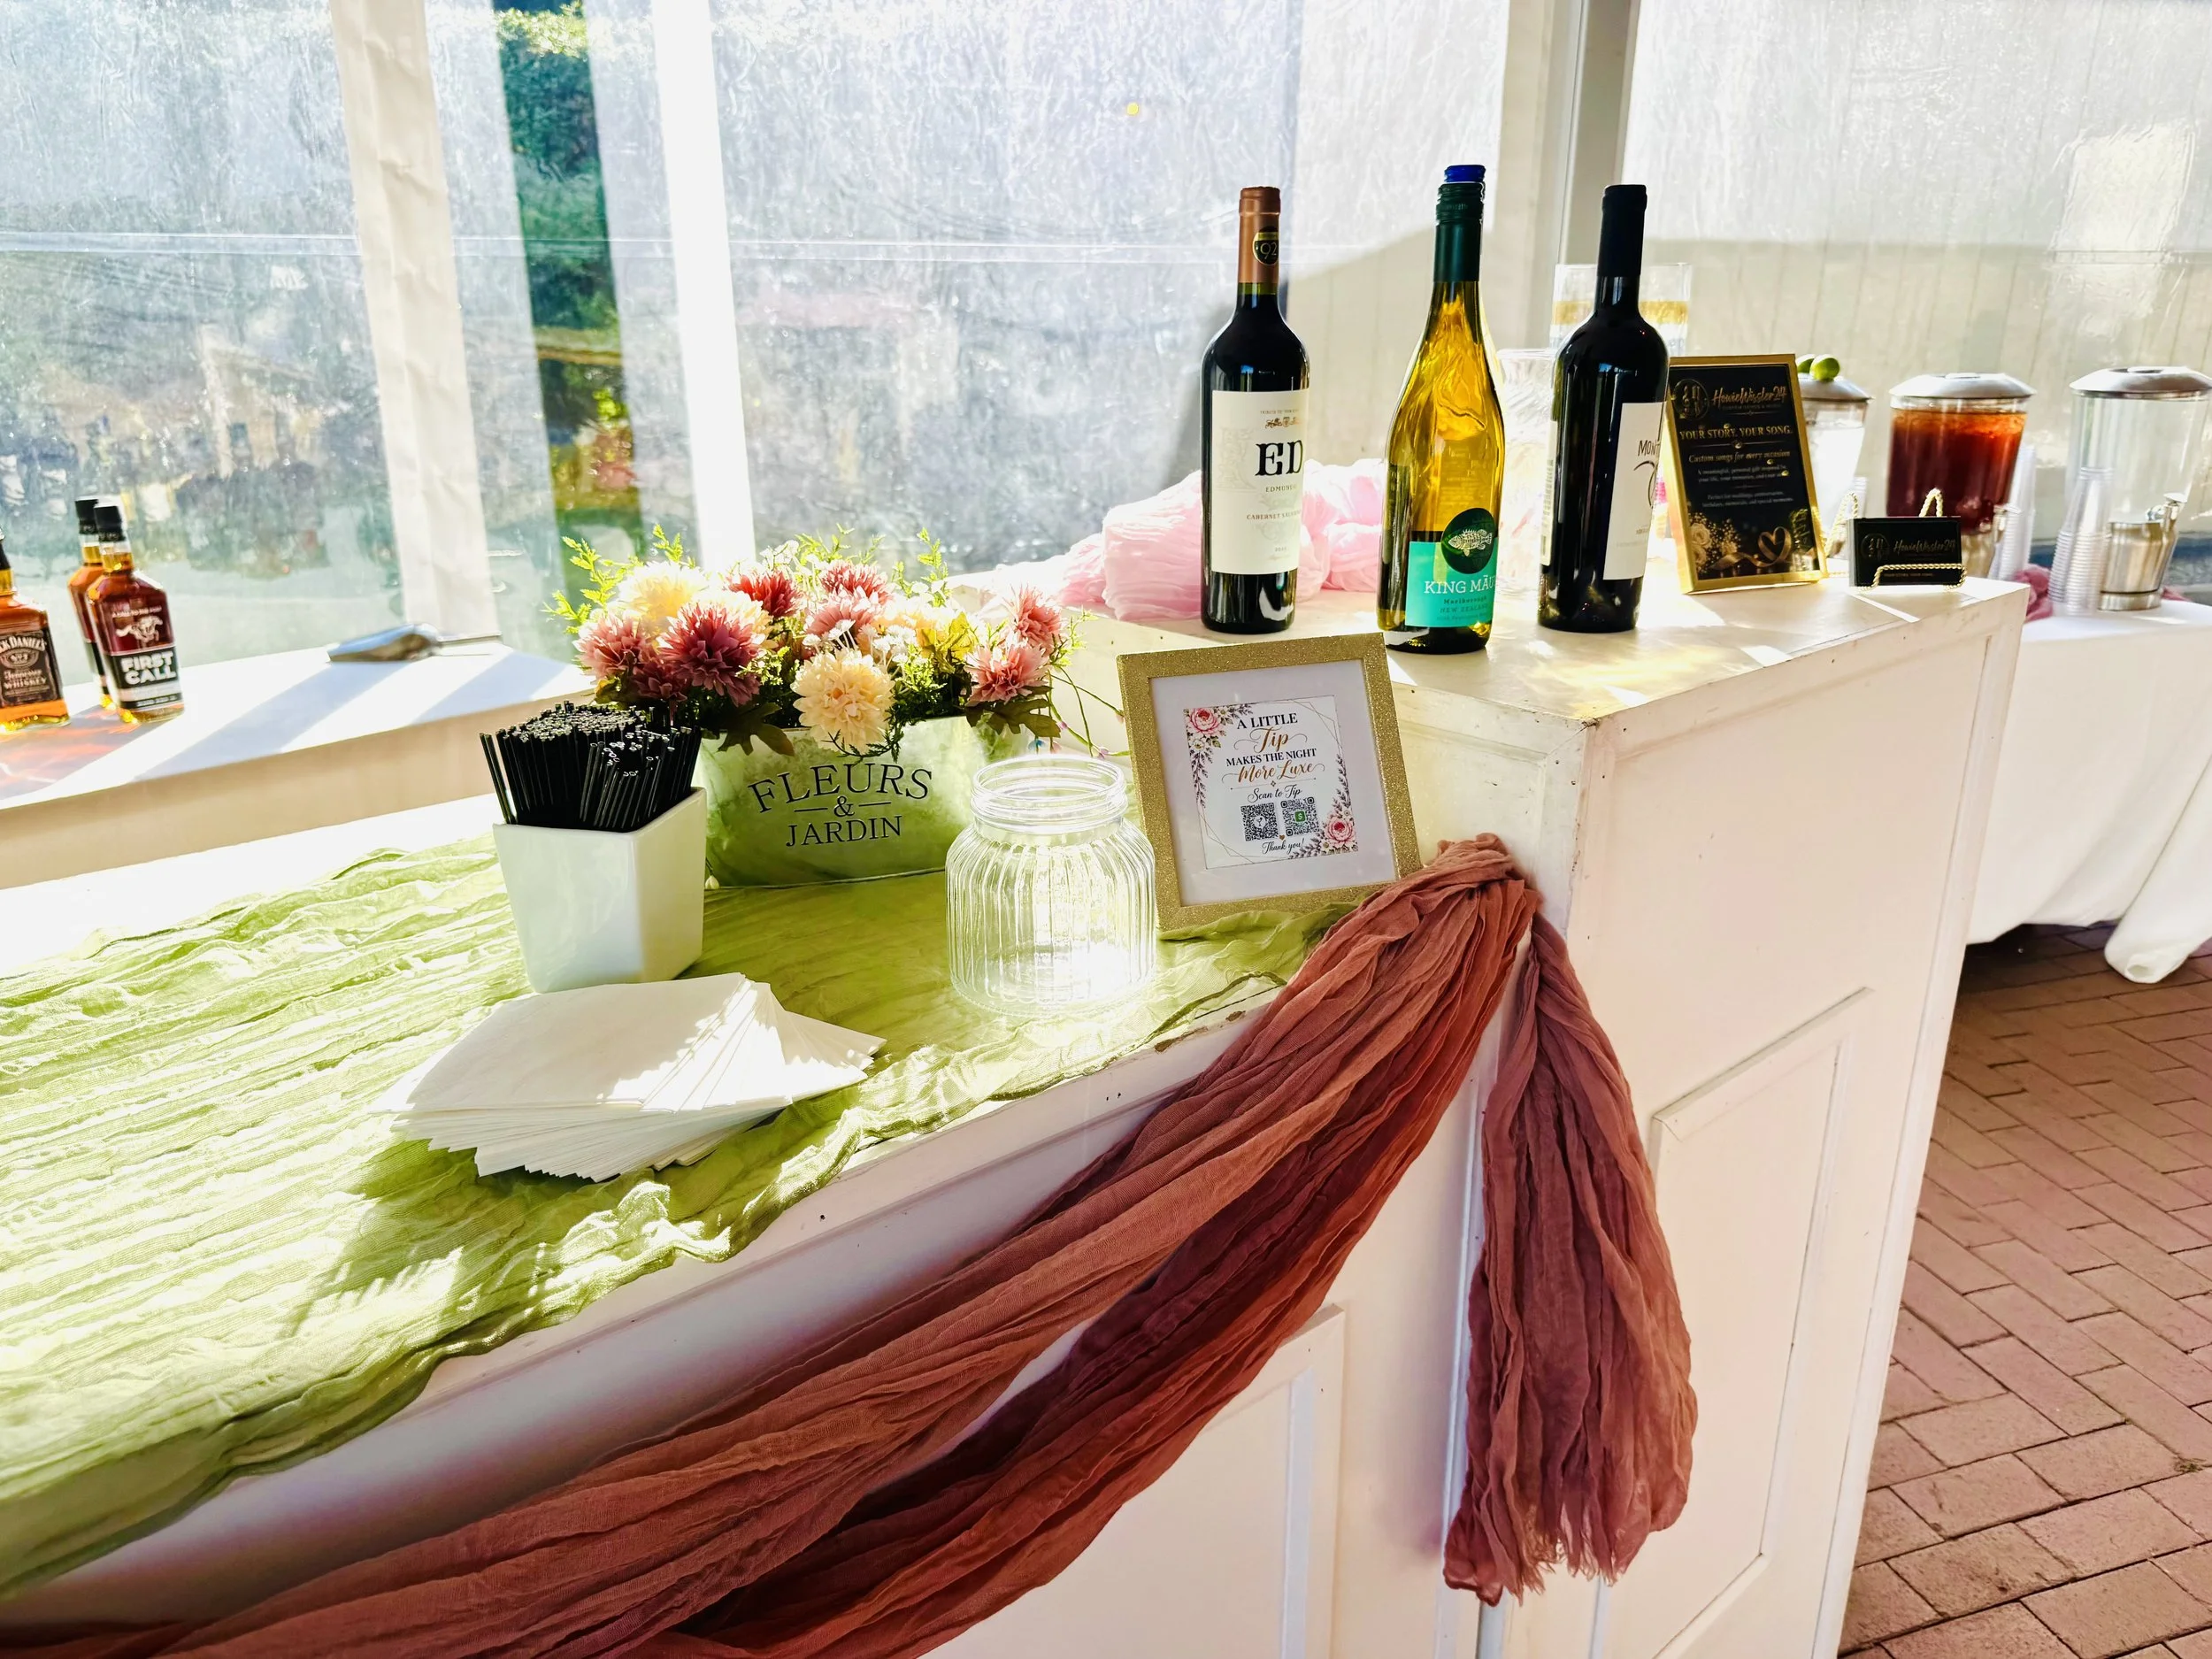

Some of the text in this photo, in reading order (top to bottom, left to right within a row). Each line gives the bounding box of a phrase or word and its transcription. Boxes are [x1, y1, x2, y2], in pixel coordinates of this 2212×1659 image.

[1260, 242, 1278, 259] 92
[1679, 430, 1706, 440] YOUR
[1740, 426, 1764, 437] YOUR
[1688, 454, 1714, 463] Custom
[1734, 451, 1744, 463] for
[1424, 580, 1466, 595] KING
[120, 650, 175, 672] FIRST
[125, 665, 177, 685] CALL
[1237, 712, 1298, 729] A LITTLE
[1225, 748, 1317, 767] MAKES THE NIGHT
[1238, 759, 1313, 783] More Luxe
[748, 763, 932, 813] FLEURS
[1248, 784, 1302, 803] Scan to Tip
[833, 795, 855, 817] &
[786, 815, 902, 847] JARDIN
[1262, 838, 1305, 855] Thank you!
